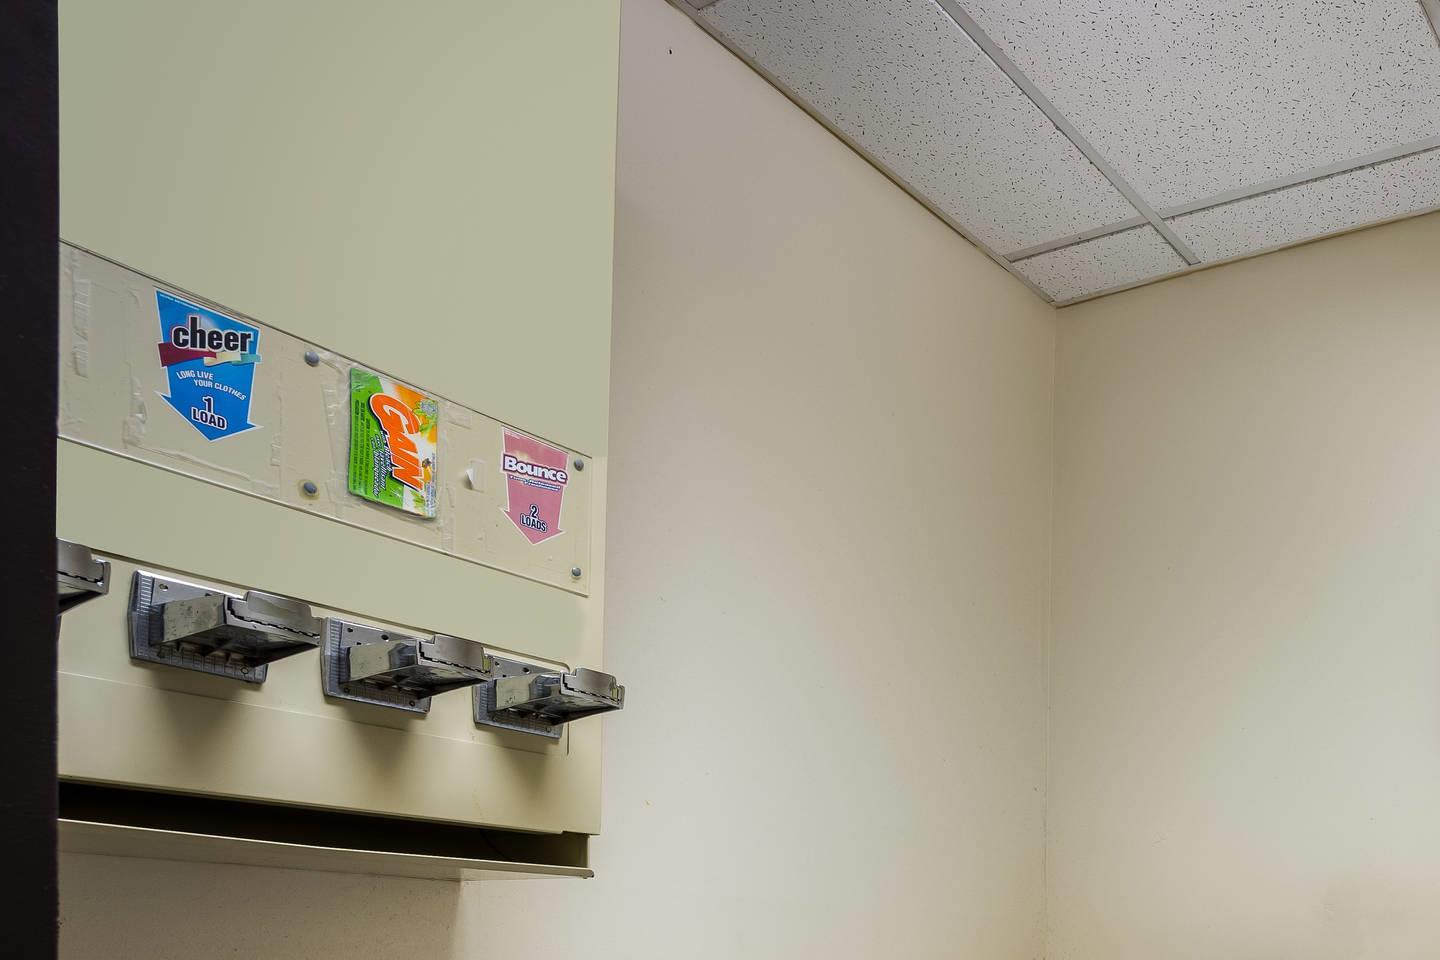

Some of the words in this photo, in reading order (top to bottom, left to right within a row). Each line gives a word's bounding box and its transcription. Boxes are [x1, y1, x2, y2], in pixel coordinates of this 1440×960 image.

[172, 316, 252, 352] cheer
[176, 370, 196, 380] LONG
[197, 370, 214, 381] LIVE
[194, 379, 213, 389] YOUR
[214, 382, 247, 401] CLOTHES
[203, 397, 213, 413] 1
[192, 407, 227, 429] LOAD
[369, 392, 425, 492] GAIN
[503, 455, 568, 483] Bounce
[530, 505, 538, 518] 2
[521, 514, 547, 532] LOADS
